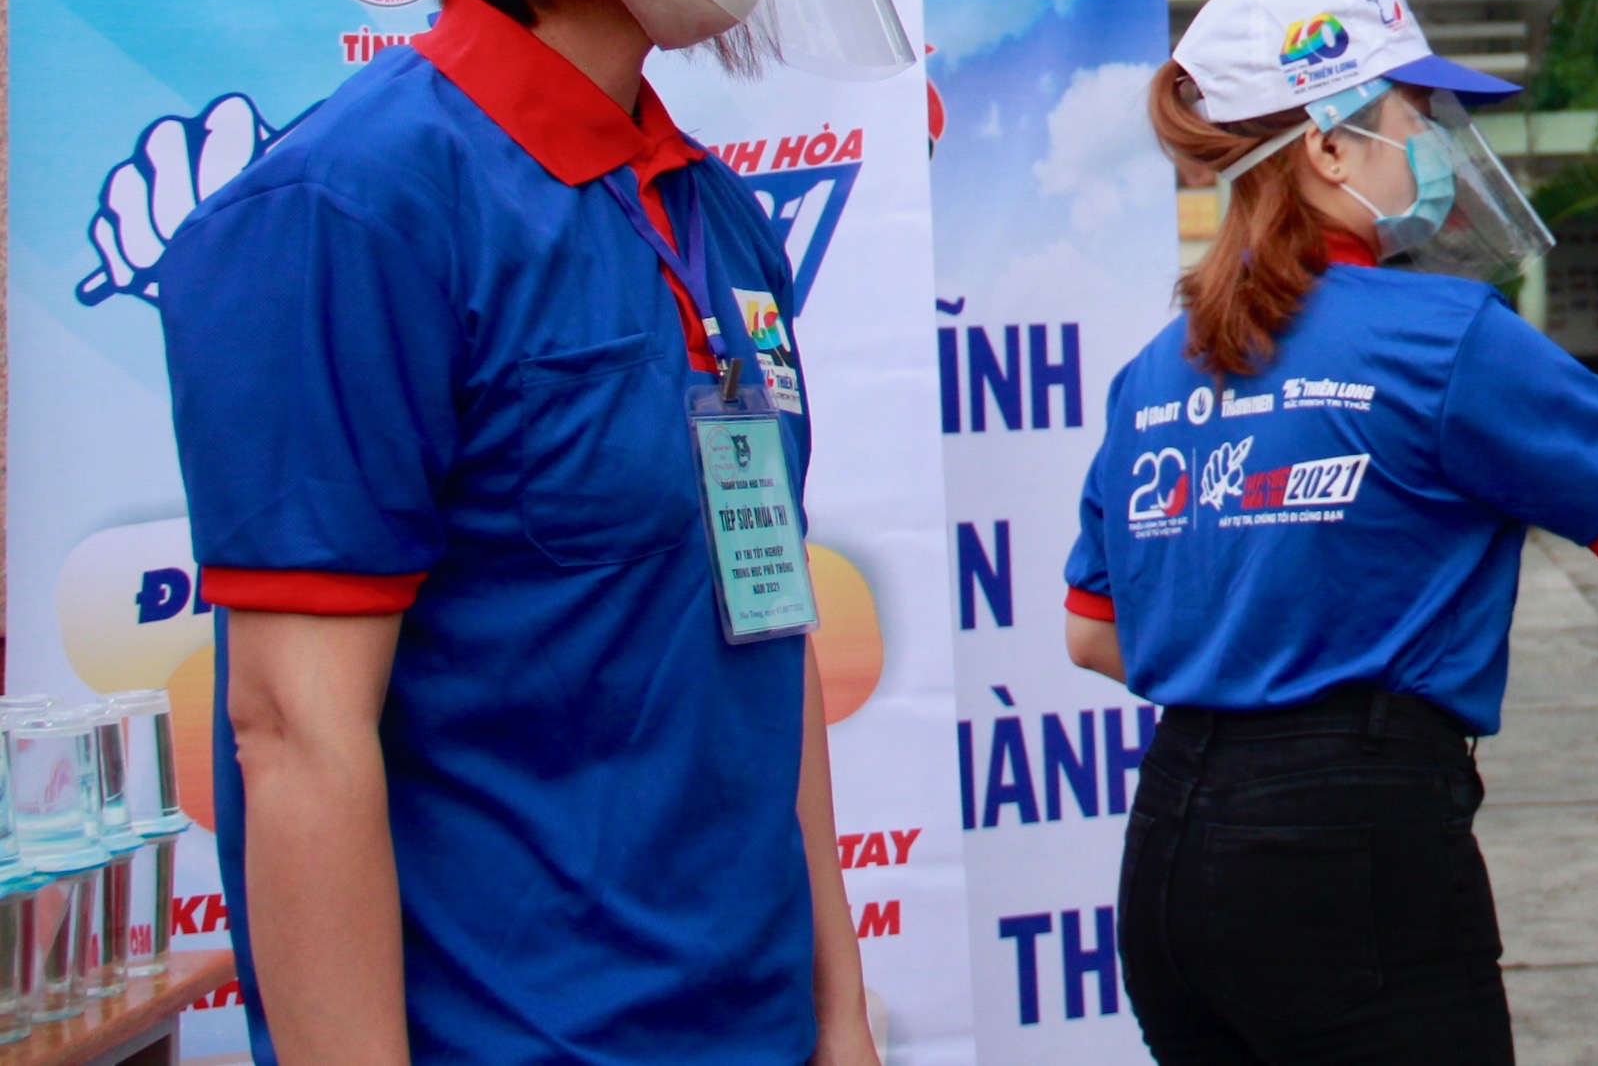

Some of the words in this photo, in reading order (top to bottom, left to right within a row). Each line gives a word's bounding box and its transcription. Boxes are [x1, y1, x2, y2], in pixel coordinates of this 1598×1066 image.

[1337, 382, 1375, 401] LONG
[1287, 460, 1361, 500] 2021
[773, 505, 788, 526] THI
[838, 828, 922, 869] TAY
[1000, 905, 1119, 1025] TH
